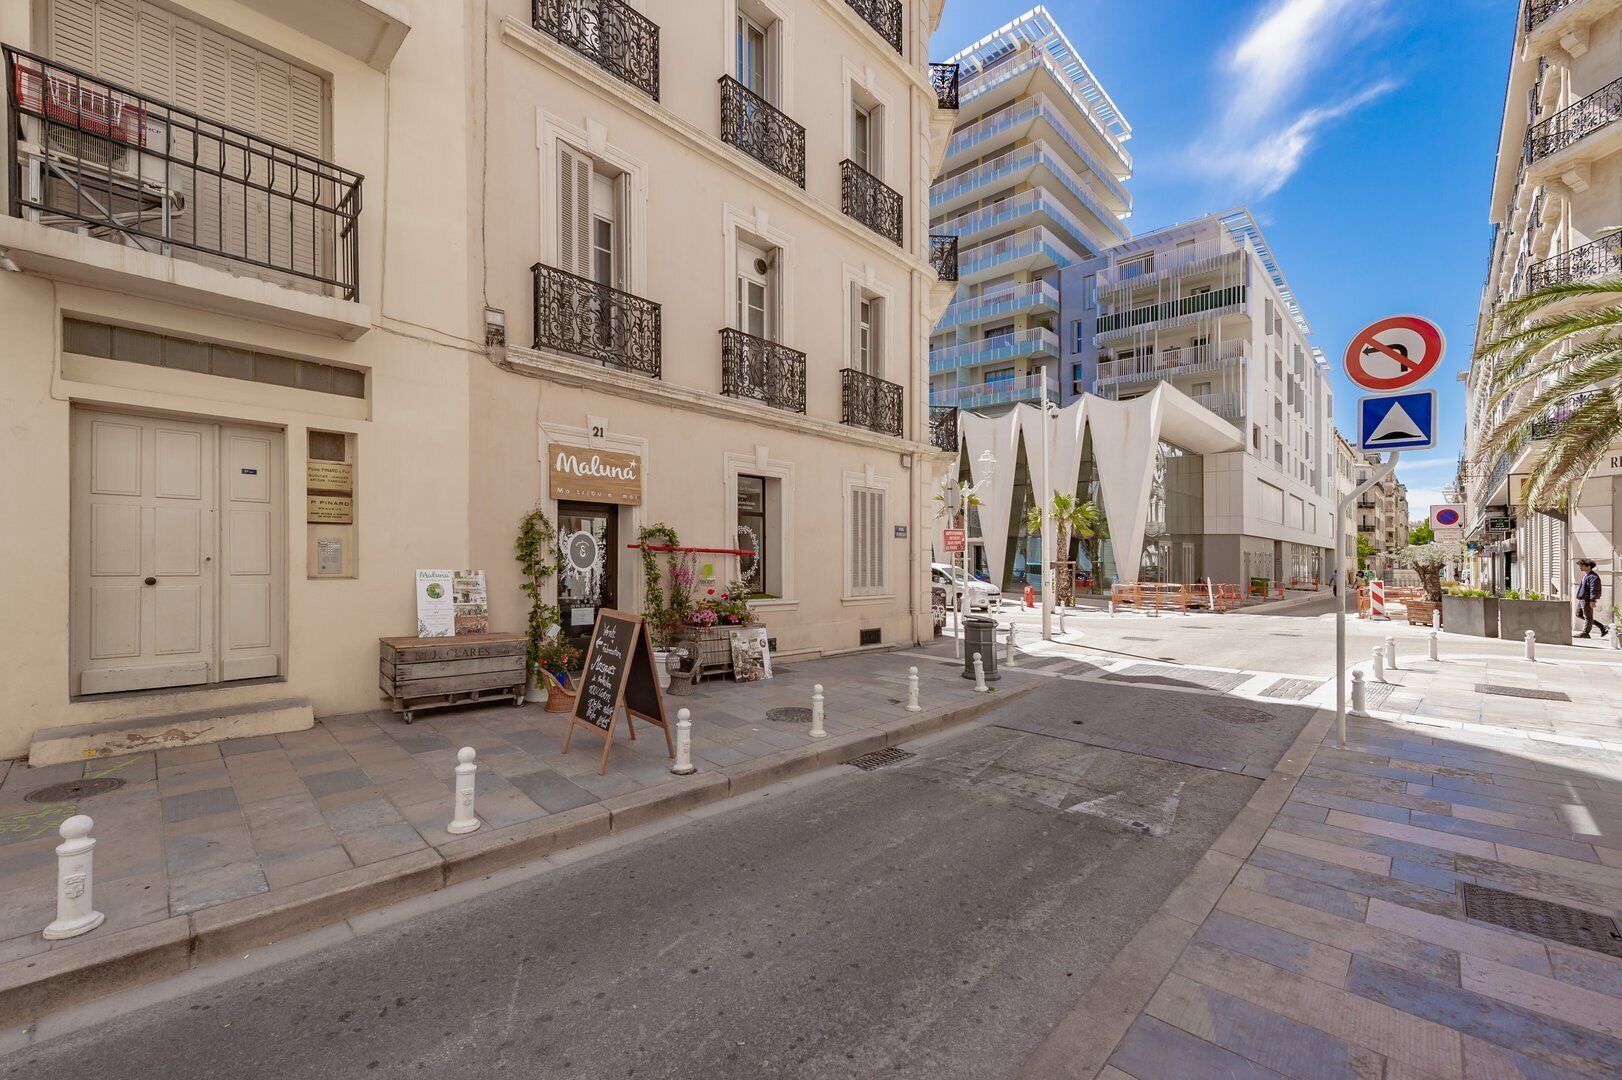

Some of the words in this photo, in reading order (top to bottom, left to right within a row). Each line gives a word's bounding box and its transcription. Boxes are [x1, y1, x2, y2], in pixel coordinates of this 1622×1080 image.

[592, 426, 604, 438] 21
[556, 452, 637, 480] Maluna
[1611, 456, 1622, 468] R
[446, 647, 490, 658] CLARES
